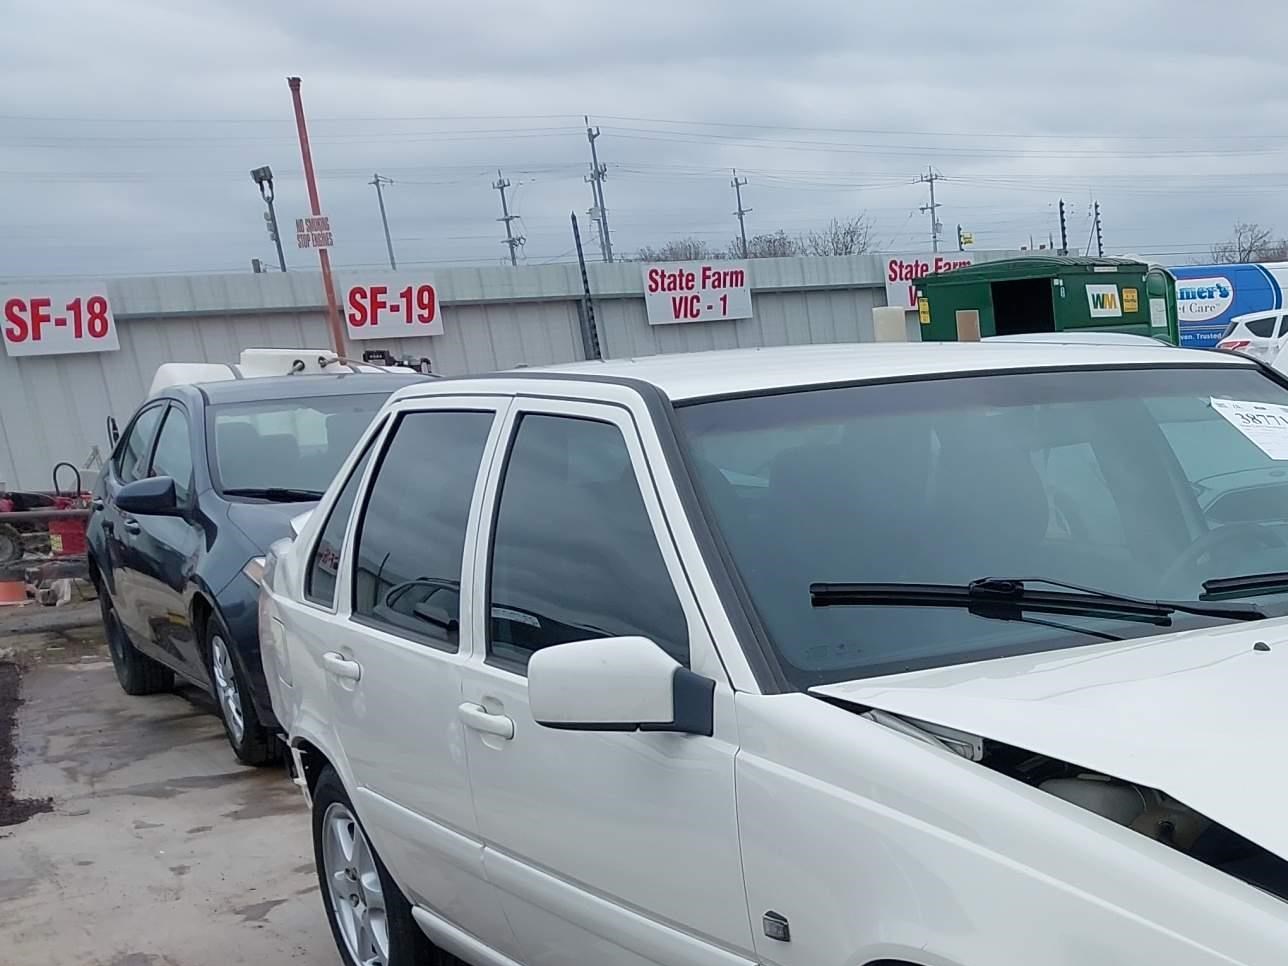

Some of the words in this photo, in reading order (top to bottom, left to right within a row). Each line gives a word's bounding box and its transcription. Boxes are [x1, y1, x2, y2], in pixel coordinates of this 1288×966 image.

[648, 268, 696, 293] State
[701, 266, 745, 290] Farm
[888, 259, 929, 282] State
[1091, 293, 1117, 310] WM
[1178, 283, 1230, 300] mer's
[348, 285, 435, 327] SF-19
[672, 294, 701, 319] VIC
[719, 293, 728, 316] 1
[1189, 303, 1216, 313] Care
[4, 296, 109, 343] SF-18
